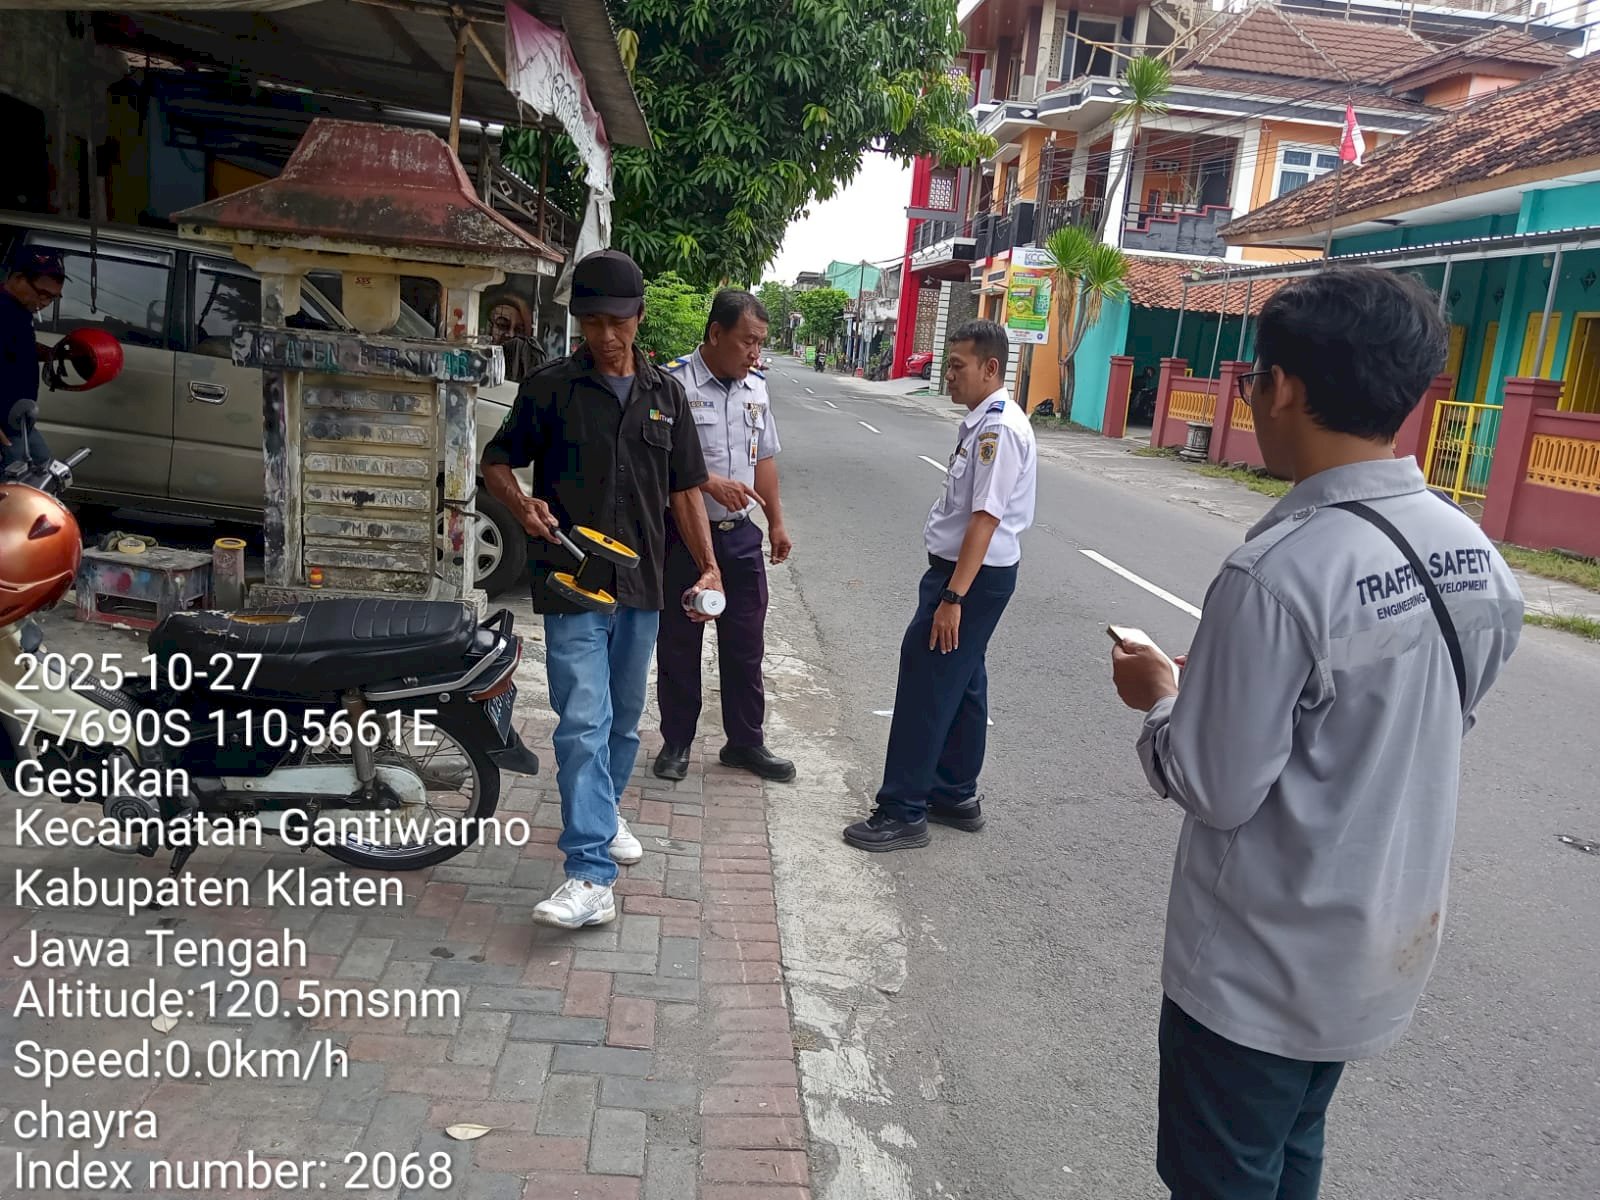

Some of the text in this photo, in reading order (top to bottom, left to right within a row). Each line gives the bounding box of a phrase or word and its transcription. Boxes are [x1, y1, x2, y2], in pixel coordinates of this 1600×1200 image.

[1356, 548, 1492, 606] TRAFFI SAFETY
[1376, 592, 1428, 620] ENGINEERING
